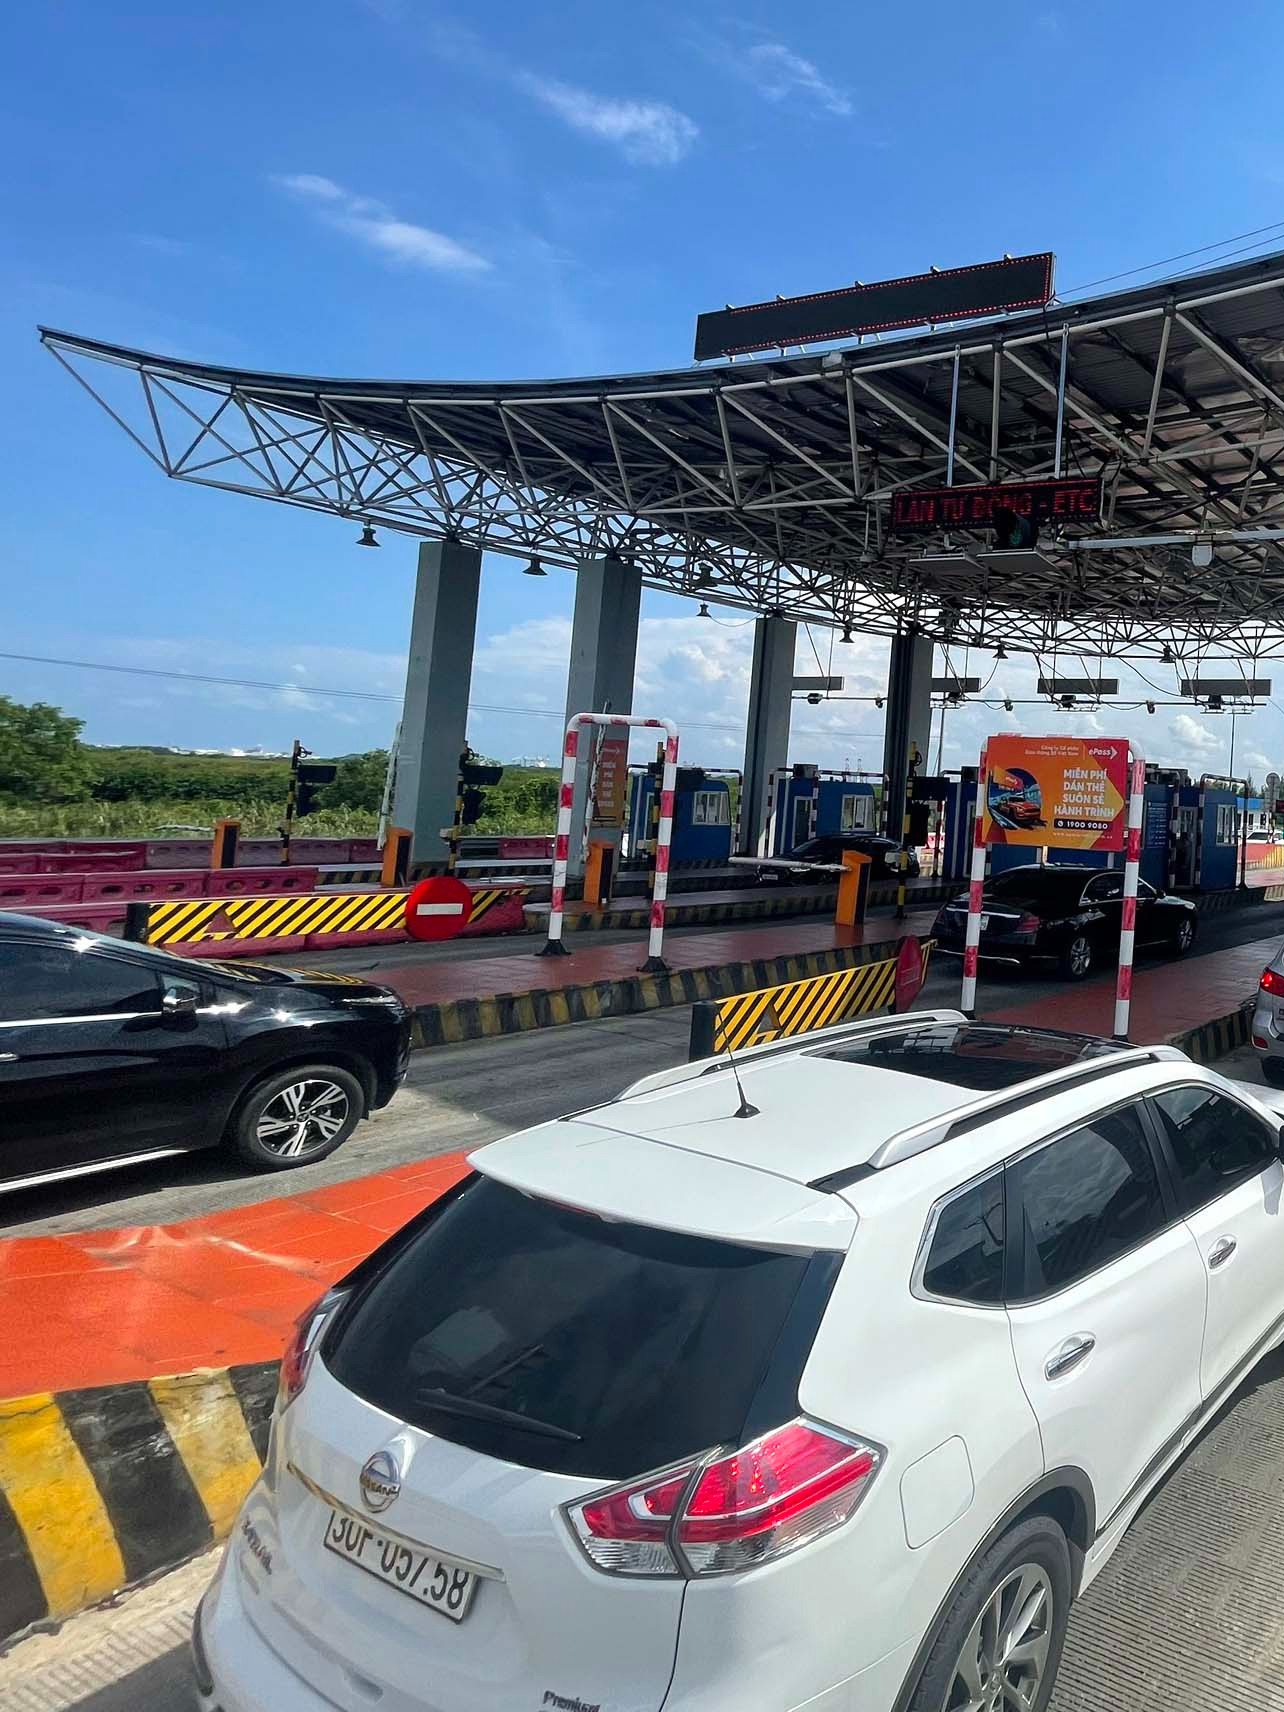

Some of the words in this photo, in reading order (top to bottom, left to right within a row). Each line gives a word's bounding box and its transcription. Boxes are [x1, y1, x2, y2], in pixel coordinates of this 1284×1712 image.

[1063, 768, 1087, 779] MIỄN
[1090, 768, 1107, 780] PHÍ
[1063, 780, 1085, 791] DÁN
[1054, 804, 1083, 816] HÀNH
[1084, 805, 1115, 817] TRÌNH
[1066, 821, 1085, 829] 1900
[1087, 822, 1108, 830] 9080
